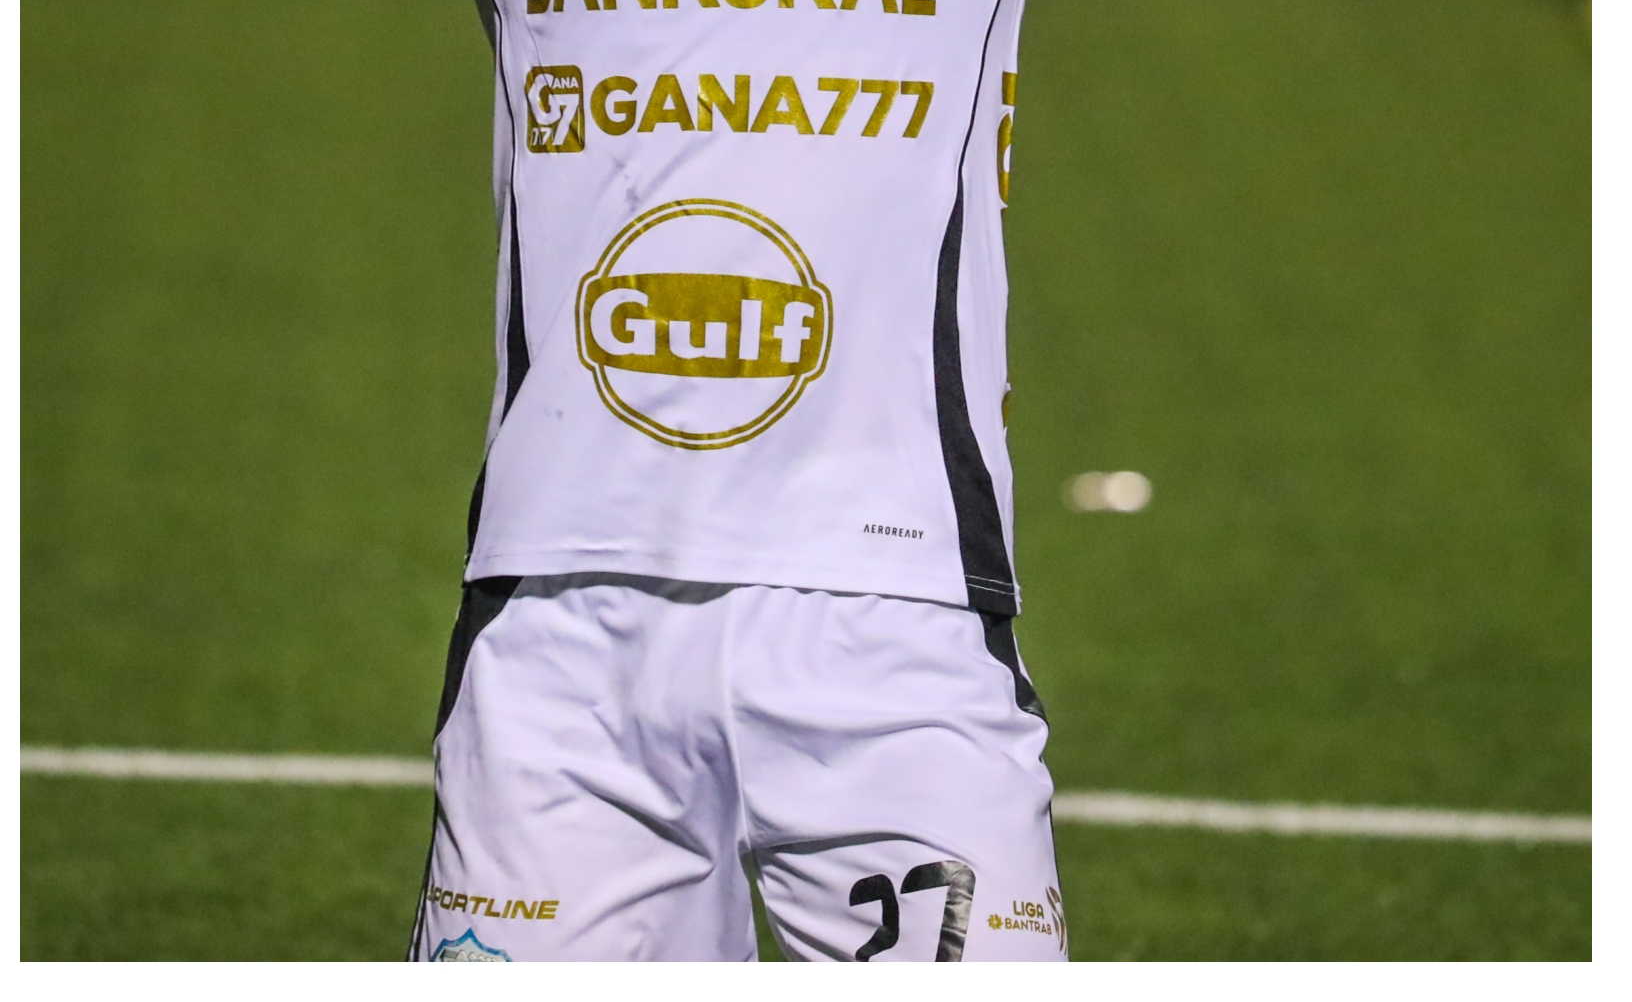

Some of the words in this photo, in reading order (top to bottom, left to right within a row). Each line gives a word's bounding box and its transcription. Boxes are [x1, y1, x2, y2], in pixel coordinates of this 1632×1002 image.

[589, 73, 935, 139] GANA777
[590, 287, 816, 364] Gulf
[863, 523, 925, 540] AEROREADY
[1013, 900, 1045, 920] LIGA
[1004, 917, 1053, 936] BANTRAB
